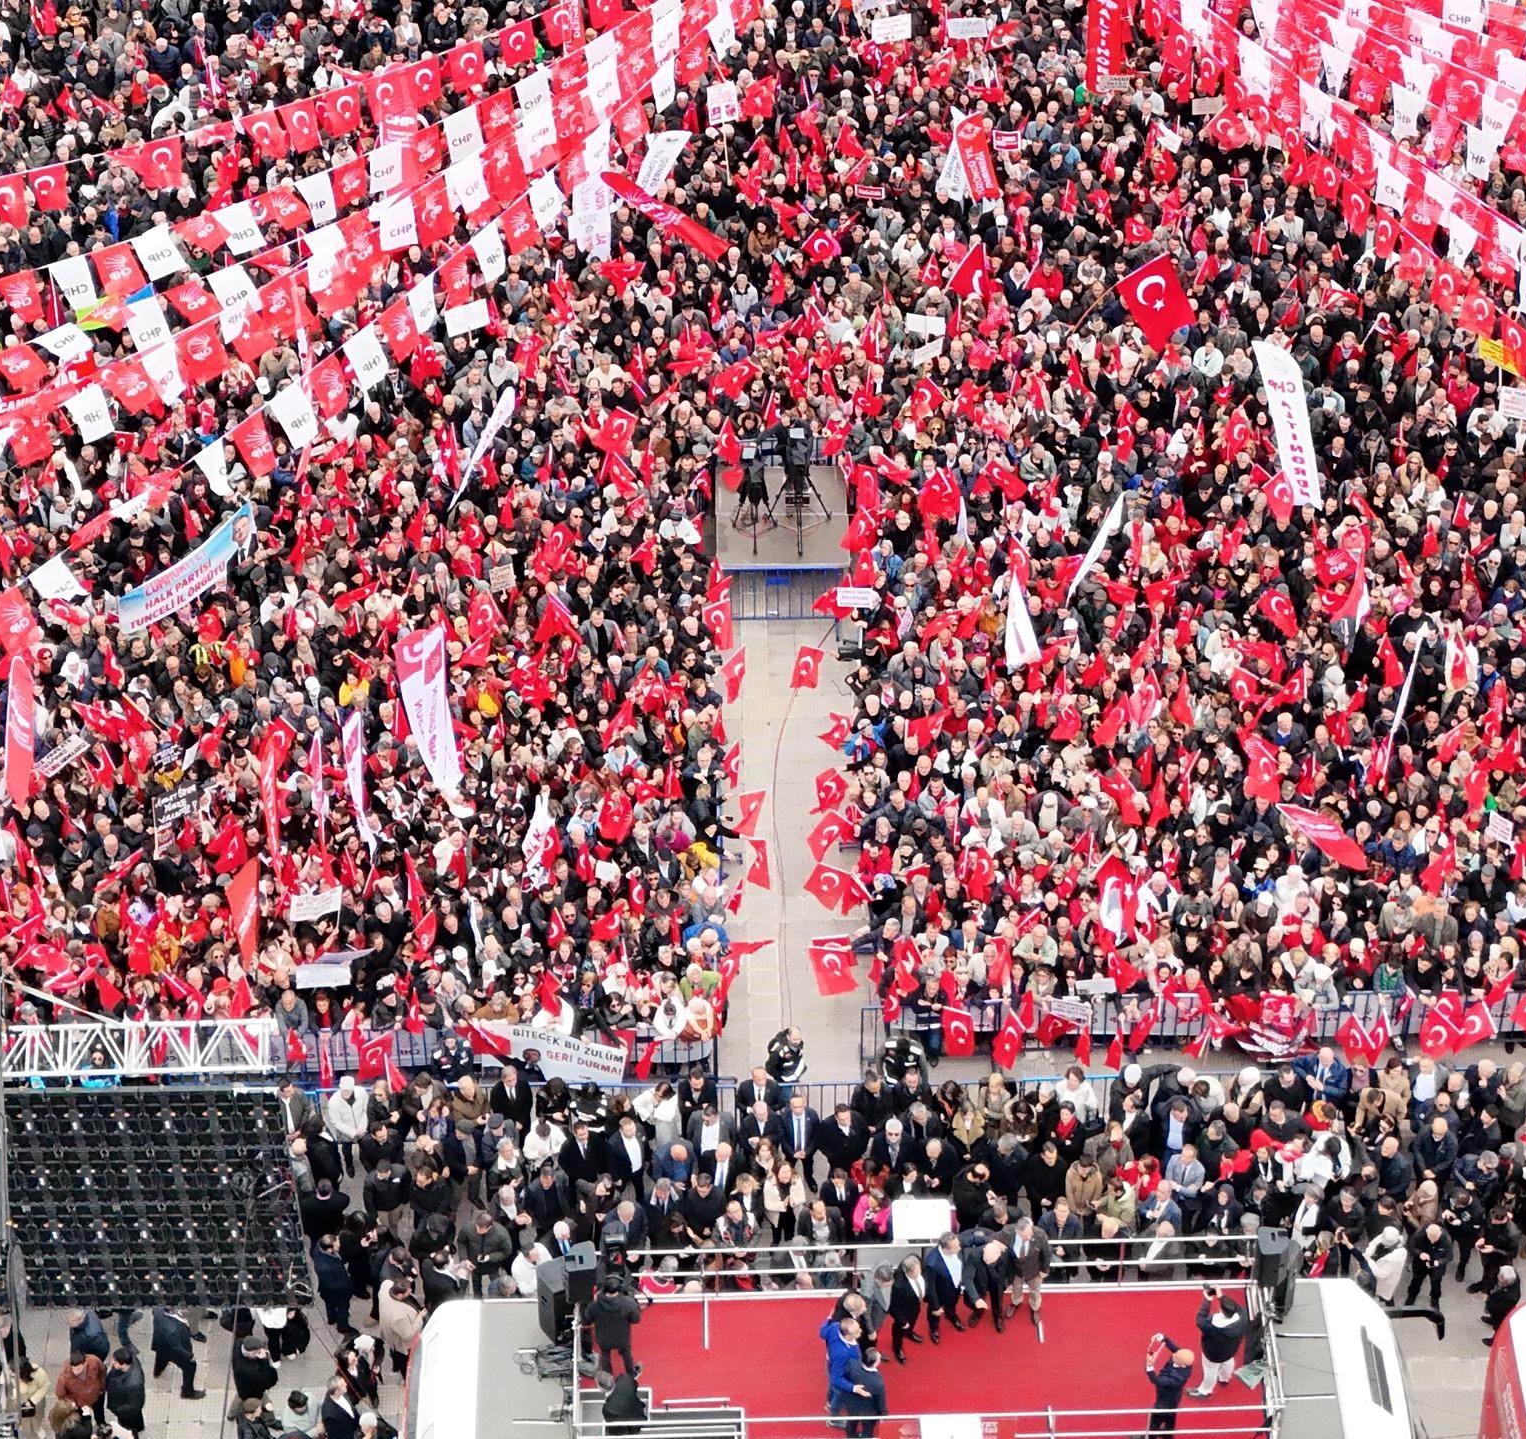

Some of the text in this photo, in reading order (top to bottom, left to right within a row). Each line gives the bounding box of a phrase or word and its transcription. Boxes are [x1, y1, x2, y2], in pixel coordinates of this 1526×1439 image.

[1448, 14, 1471, 24] CHP
[524, 94, 542, 110] CHP
[452, 133, 472, 147] CHP
[343, 178, 361, 192] CHP
[1410, 213, 1432, 227] CHP
[187, 296, 209, 311] CHP
[225, 290, 248, 306] CHP
[139, 327, 161, 342] CHP
[9, 358, 32, 374] CHP
[1329, 561, 1348, 575] CHP
[145, 558, 212, 610] HALK PARTİSİ
[131, 601, 175, 629] TUNCELİ
[564, 1041, 580, 1052] BU
[584, 1046, 624, 1064] ZULÜM
[546, 1050, 622, 1076] GERİ DURMA!
